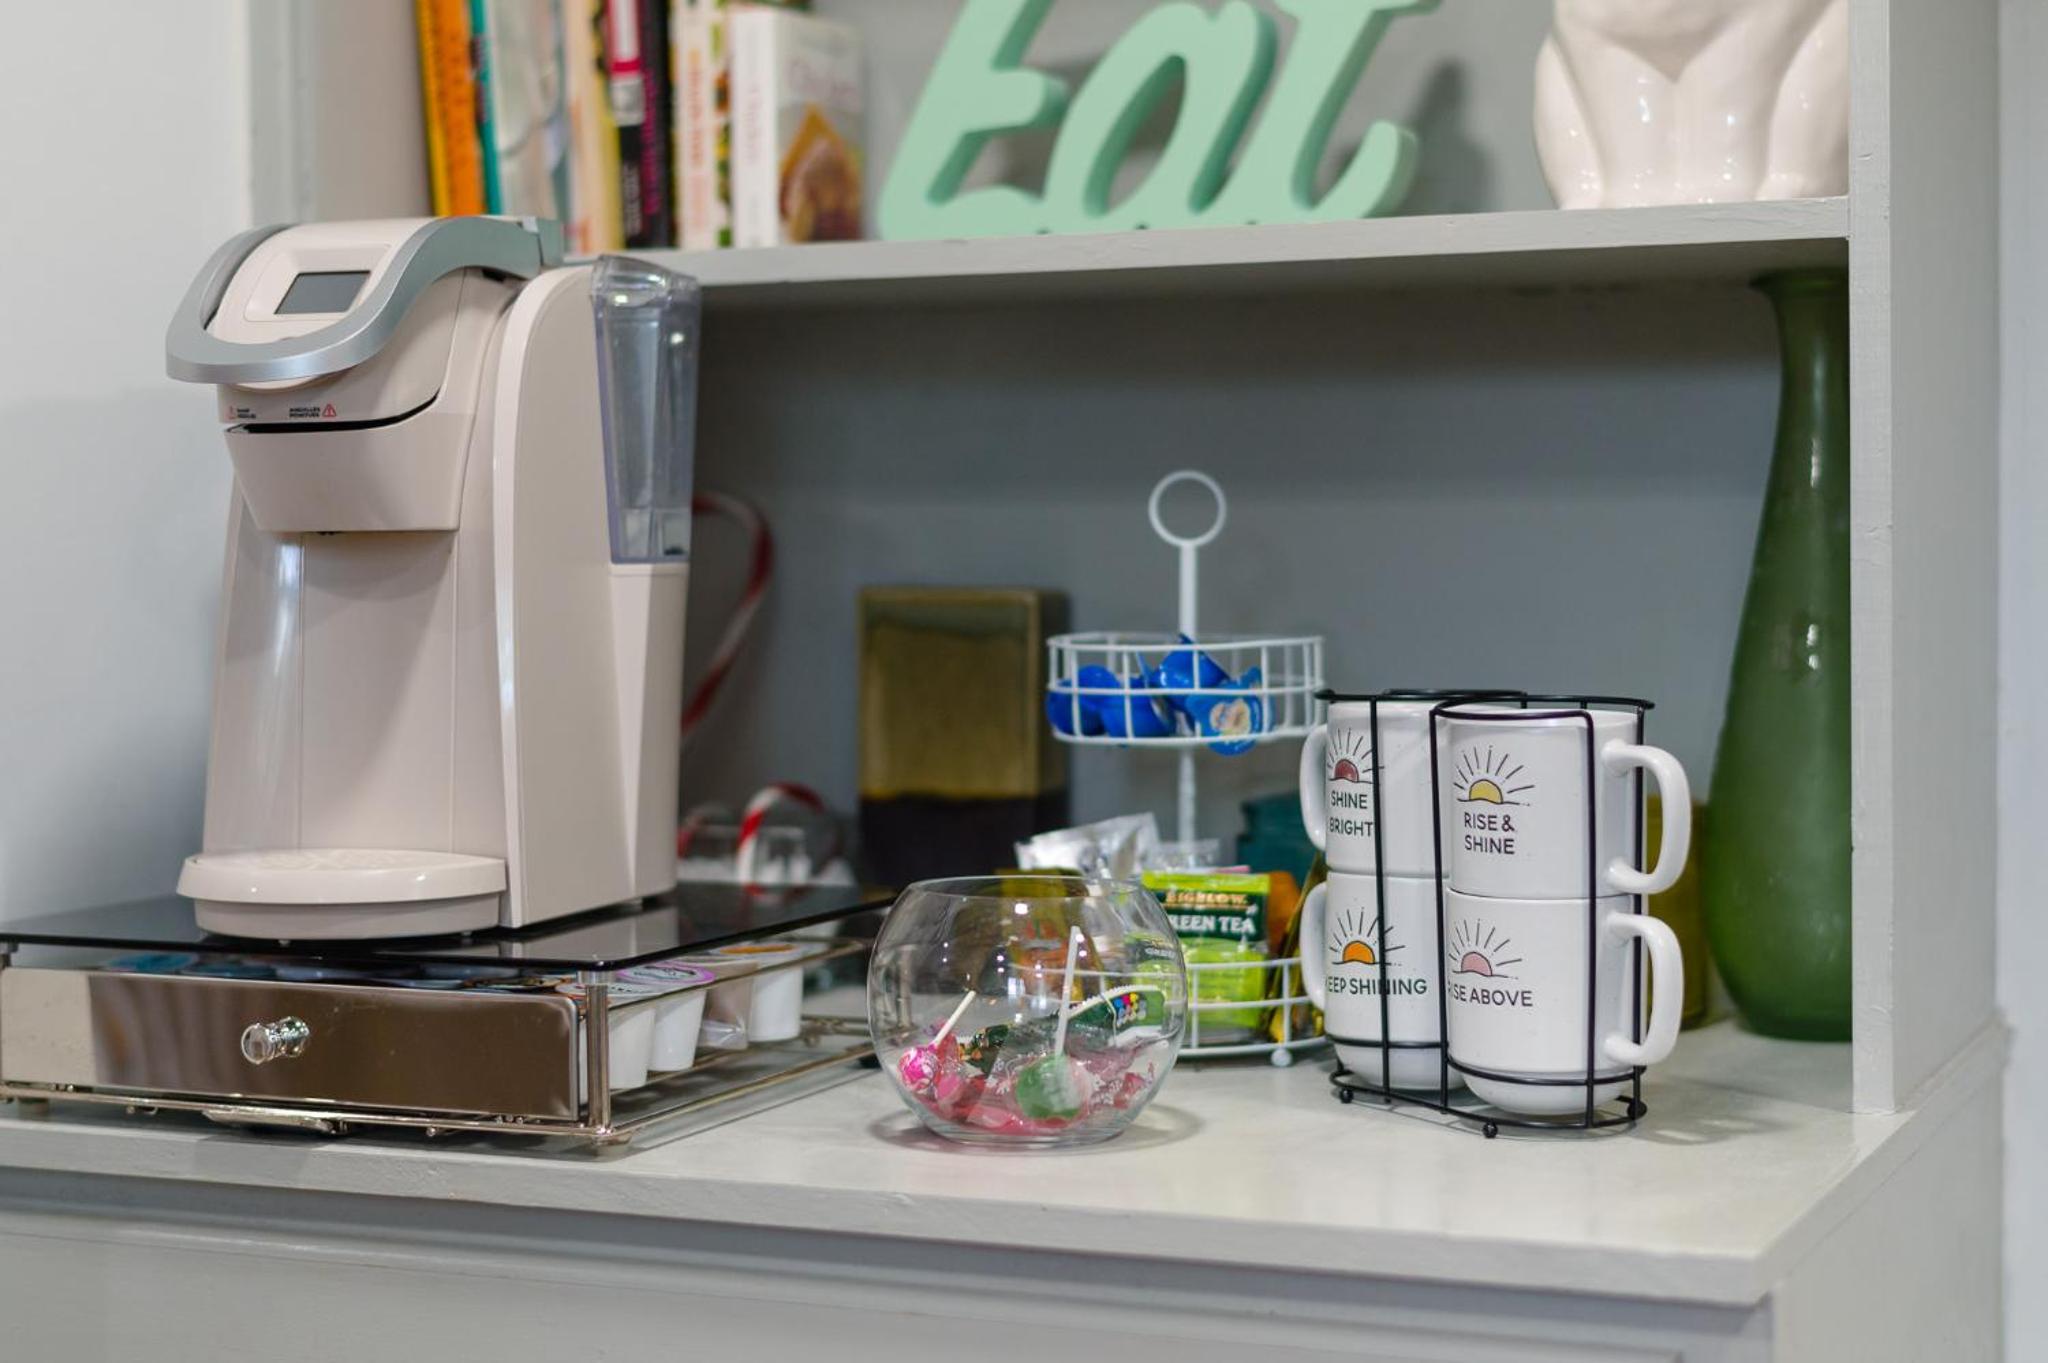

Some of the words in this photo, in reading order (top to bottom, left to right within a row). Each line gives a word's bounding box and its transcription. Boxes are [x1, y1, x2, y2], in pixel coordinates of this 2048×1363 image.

[1330, 790, 1368, 810] SHINE
[1329, 817, 1374, 837] BRIGHT
[1464, 811, 1498, 831] RISE
[1501, 814, 1515, 832] &
[1464, 834, 1515, 855] SHINE
[1218, 916, 1256, 934] TEA
[1325, 975, 1347, 993] EEP
[1469, 988, 1533, 1007] ABOVE
